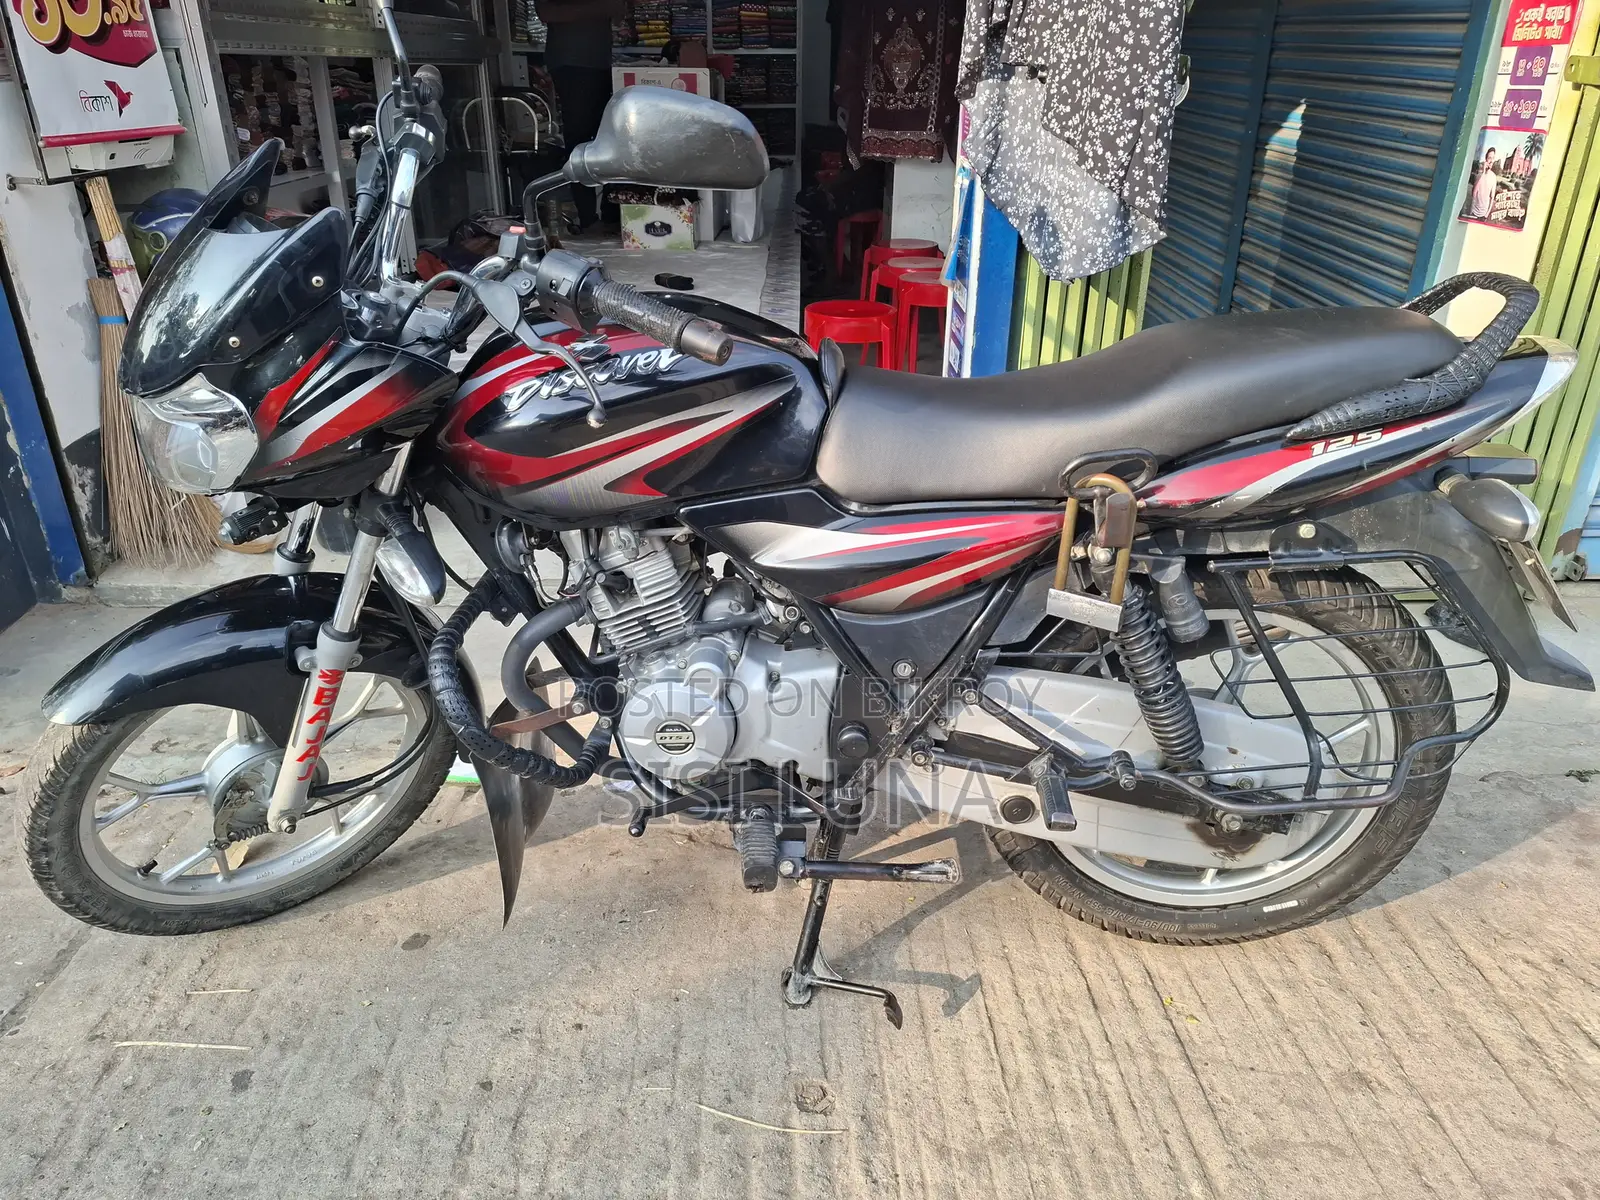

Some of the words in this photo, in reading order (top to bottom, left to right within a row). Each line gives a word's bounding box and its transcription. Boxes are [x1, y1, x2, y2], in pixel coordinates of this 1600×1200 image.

[78, 89, 115, 112] বিকাশ
[1311, 428, 1384, 457] 125
[296, 686, 340, 781] BAJAJ
[1054, 874, 1085, 899] NYLON
